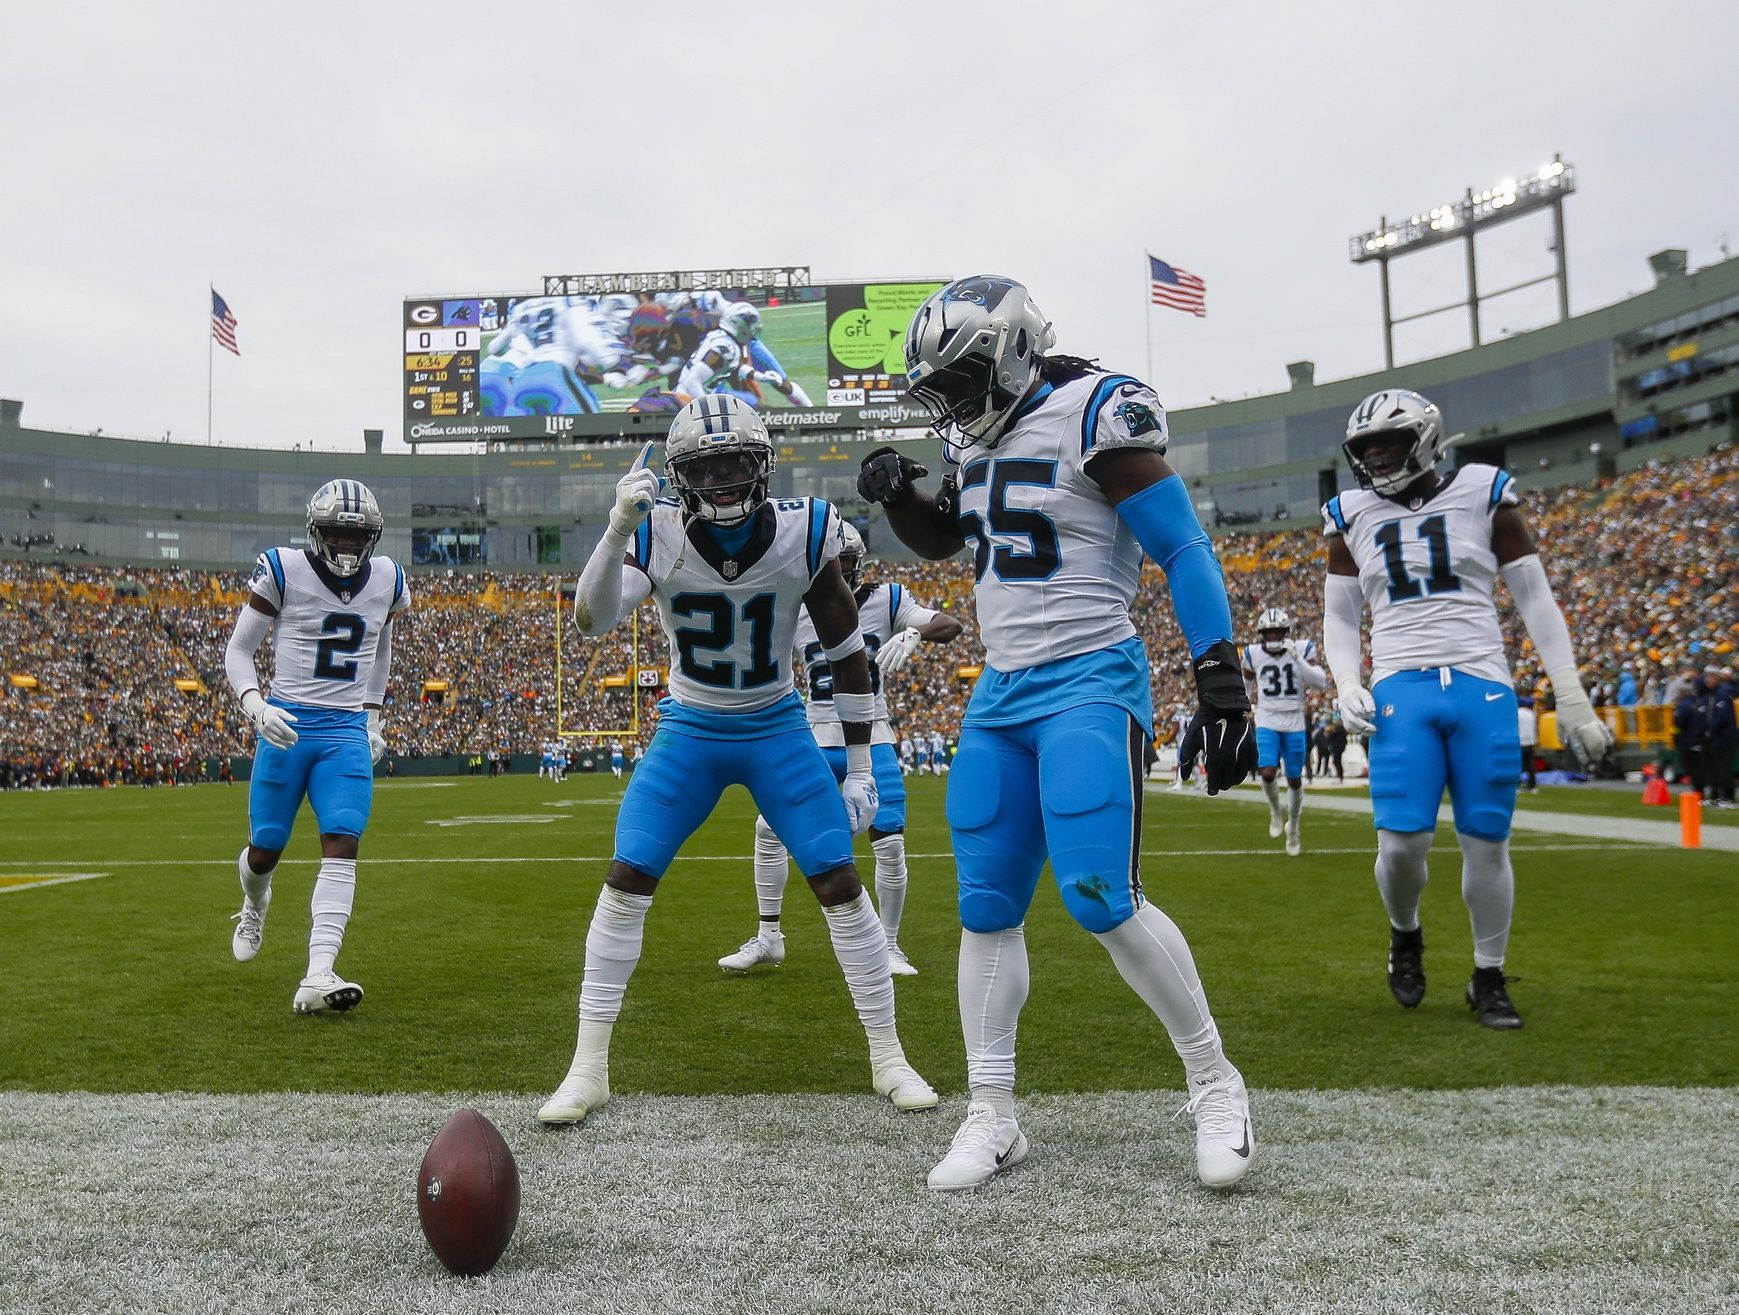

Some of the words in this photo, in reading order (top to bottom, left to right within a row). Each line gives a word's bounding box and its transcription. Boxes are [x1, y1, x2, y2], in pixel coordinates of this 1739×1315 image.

[576, 273, 693, 293] LAMBEAU
[705, 271, 776, 287] FIELD
[420, 333, 430, 348] 0
[456, 331, 467, 347] 0
[416, 357, 441, 368] 6:34
[414, 371, 428, 382] 1ST
[435, 371, 448, 381] 10
[845, 393, 862, 402] UK
[758, 411, 842, 426] cketmaster
[858, 405, 911, 424] emplify
[446, 426, 479, 435] CASINO
[484, 425, 511, 434] HOTEL
[545, 416, 574, 434] Lite
[960, 458, 1063, 583] 55
[1374, 514, 1463, 605] 11
[313, 612, 367, 683] 2
[670, 592, 779, 690] 21
[1259, 663, 1299, 698] 31
